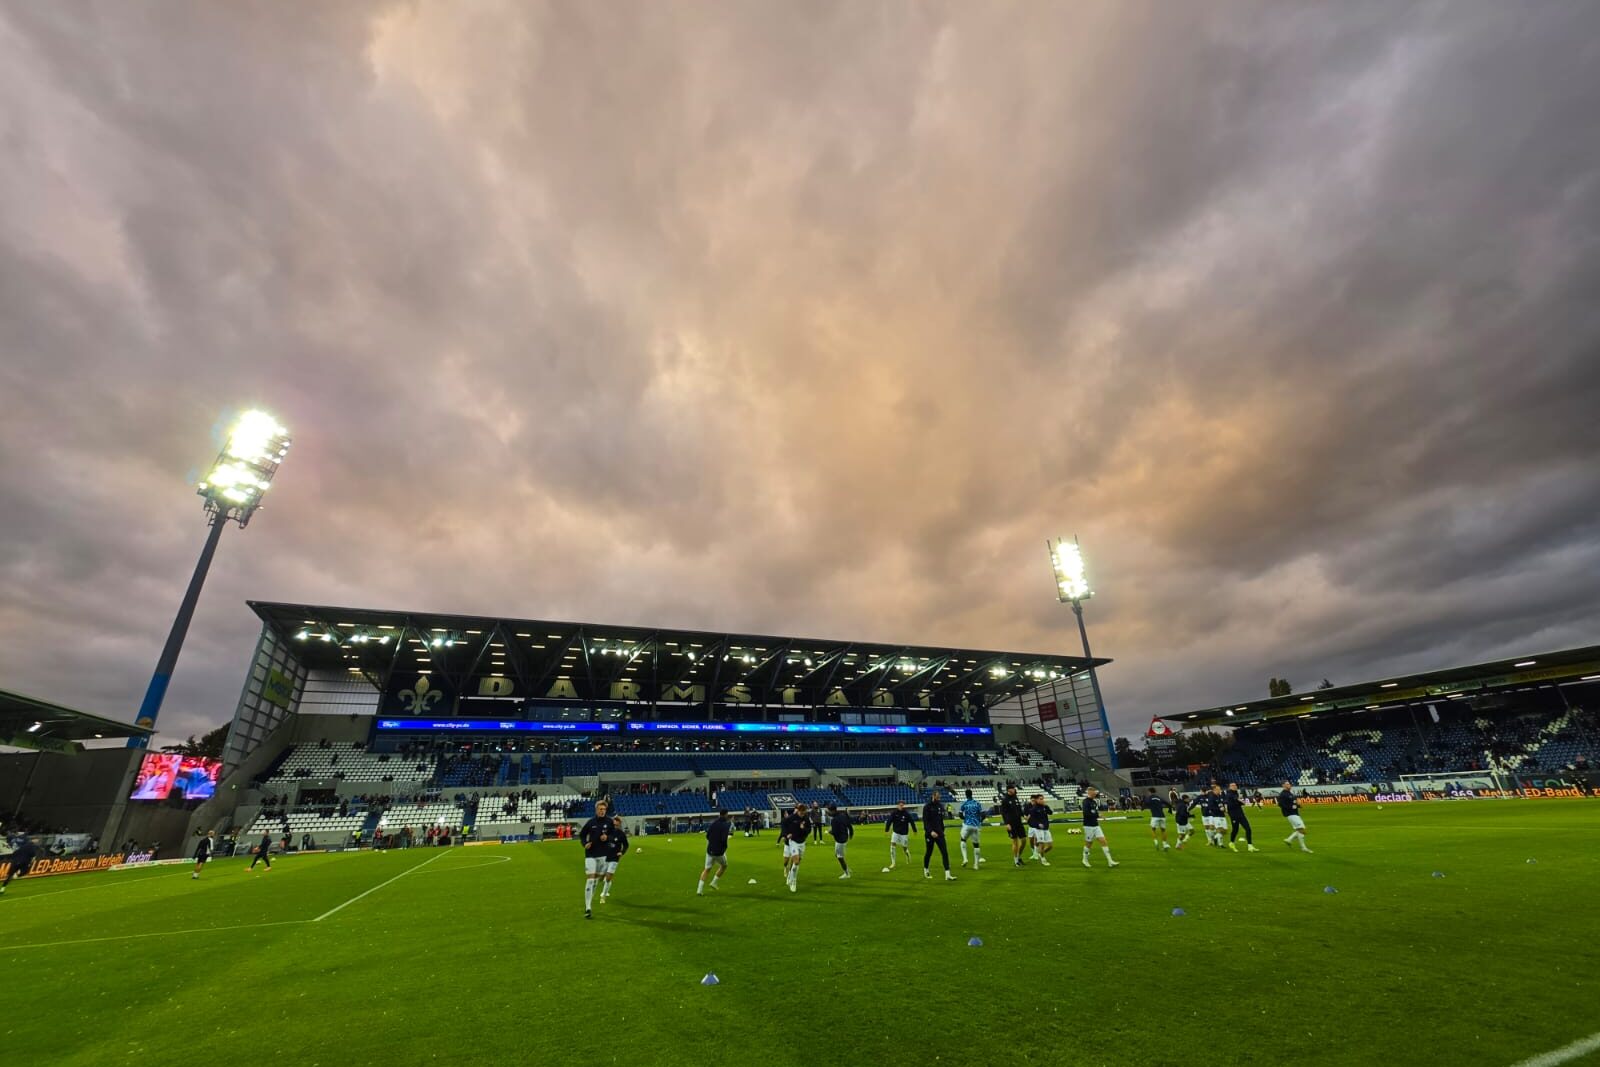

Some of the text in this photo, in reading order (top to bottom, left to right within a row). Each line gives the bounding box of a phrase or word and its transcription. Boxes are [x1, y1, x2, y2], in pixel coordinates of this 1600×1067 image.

[1516, 787, 1586, 798] LED-Band
[1335, 794, 1369, 803] Verleih!
[29, 856, 79, 875] LED-Bande
[78, 858, 97, 870] zum
